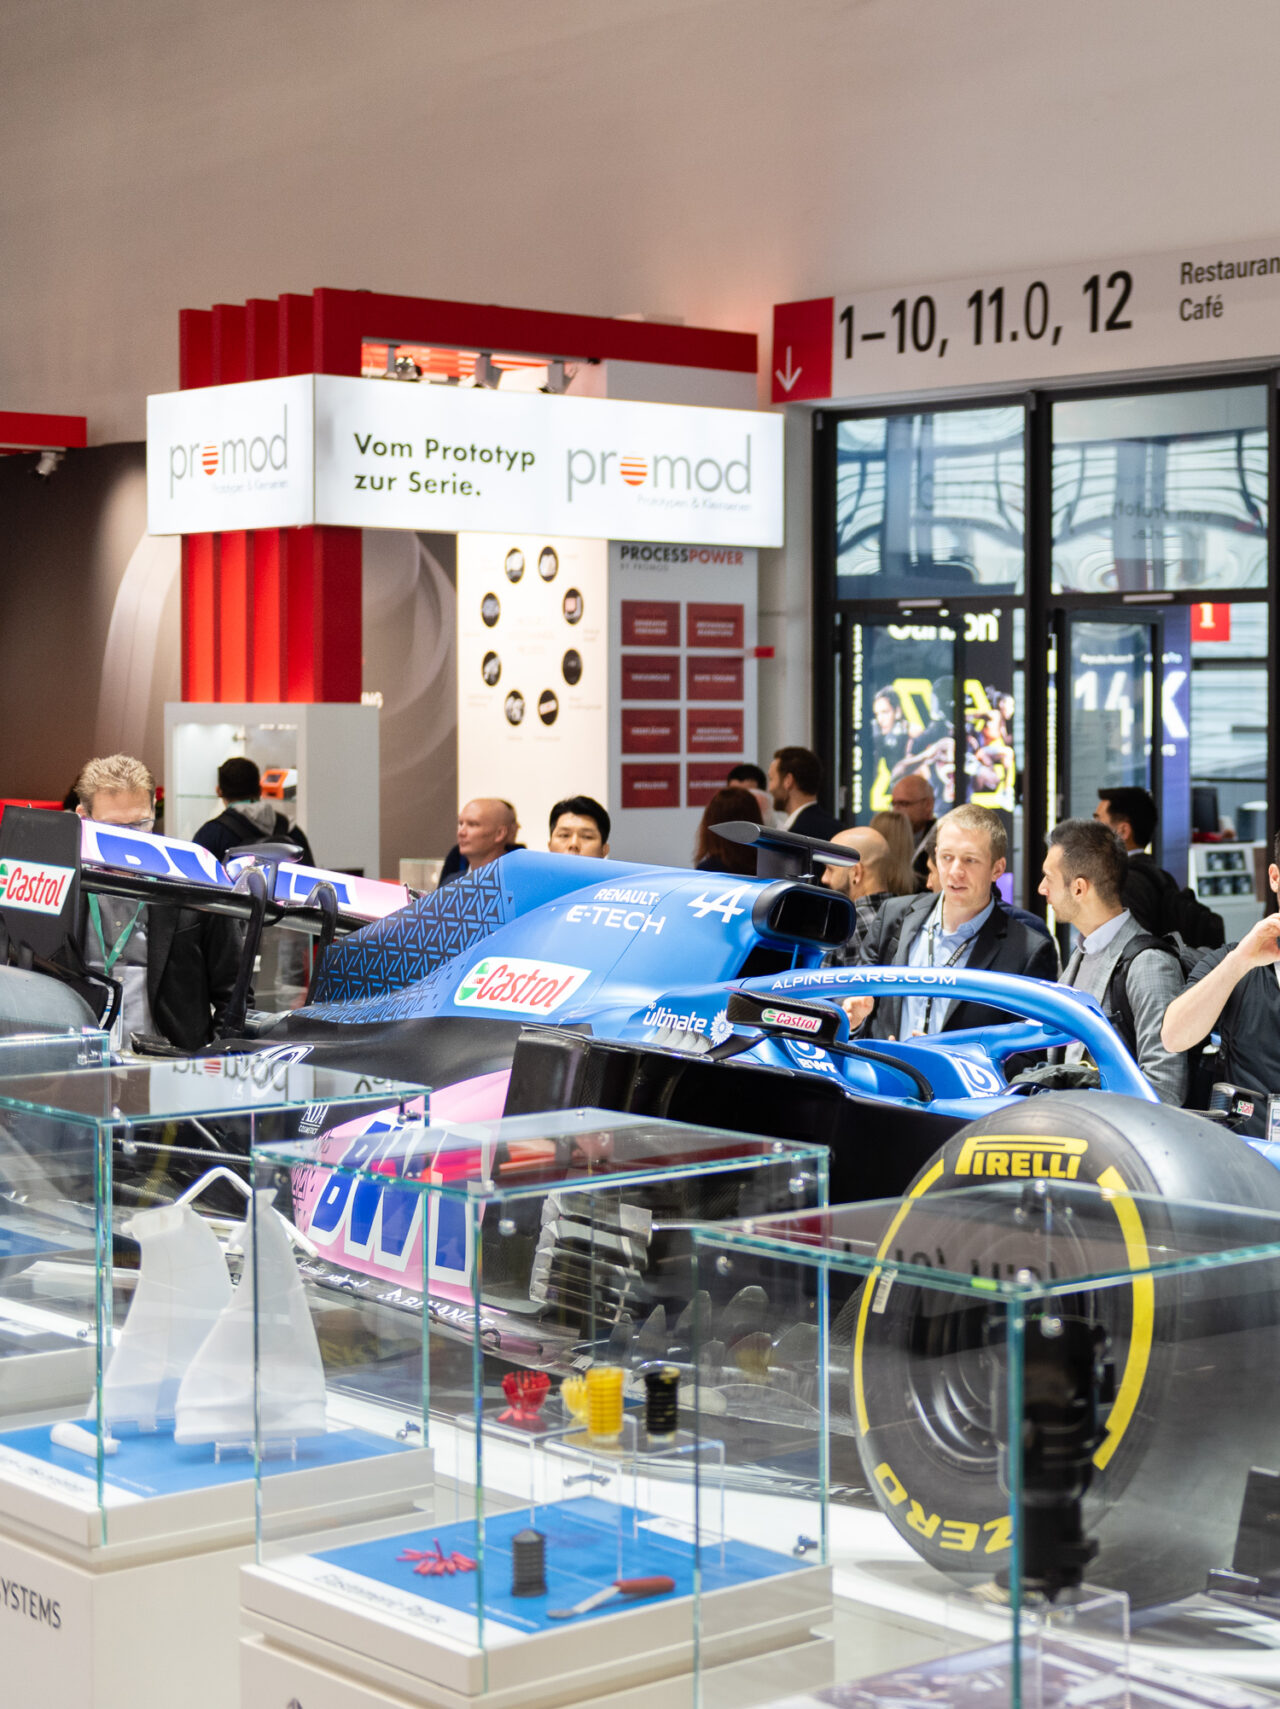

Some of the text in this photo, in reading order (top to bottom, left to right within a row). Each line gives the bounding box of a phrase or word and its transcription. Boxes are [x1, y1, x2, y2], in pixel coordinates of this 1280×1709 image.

[967, 280, 1063, 346] 11.0,
[1082, 270, 1133, 333] 12
[1179, 294, 1224, 322] Café
[353, 433, 536, 471] Vom Prototyp
[566, 434, 752, 502] promod
[354, 471, 482, 497] zur Serie.
[620, 544, 745, 566] PROCESSPOWER
[7, 867, 65, 909] Castrol
[593, 888, 656, 906] RENAULT
[476, 964, 575, 1008] Castrol
[771, 972, 957, 991] ALPINECARS.COM
[643, 1007, 708, 1034] ultimate
[776, 1012, 818, 1032] Castrol
[799, 1056, 837, 1074] BWT
[955, 1135, 1088, 1180] PIRELLI
